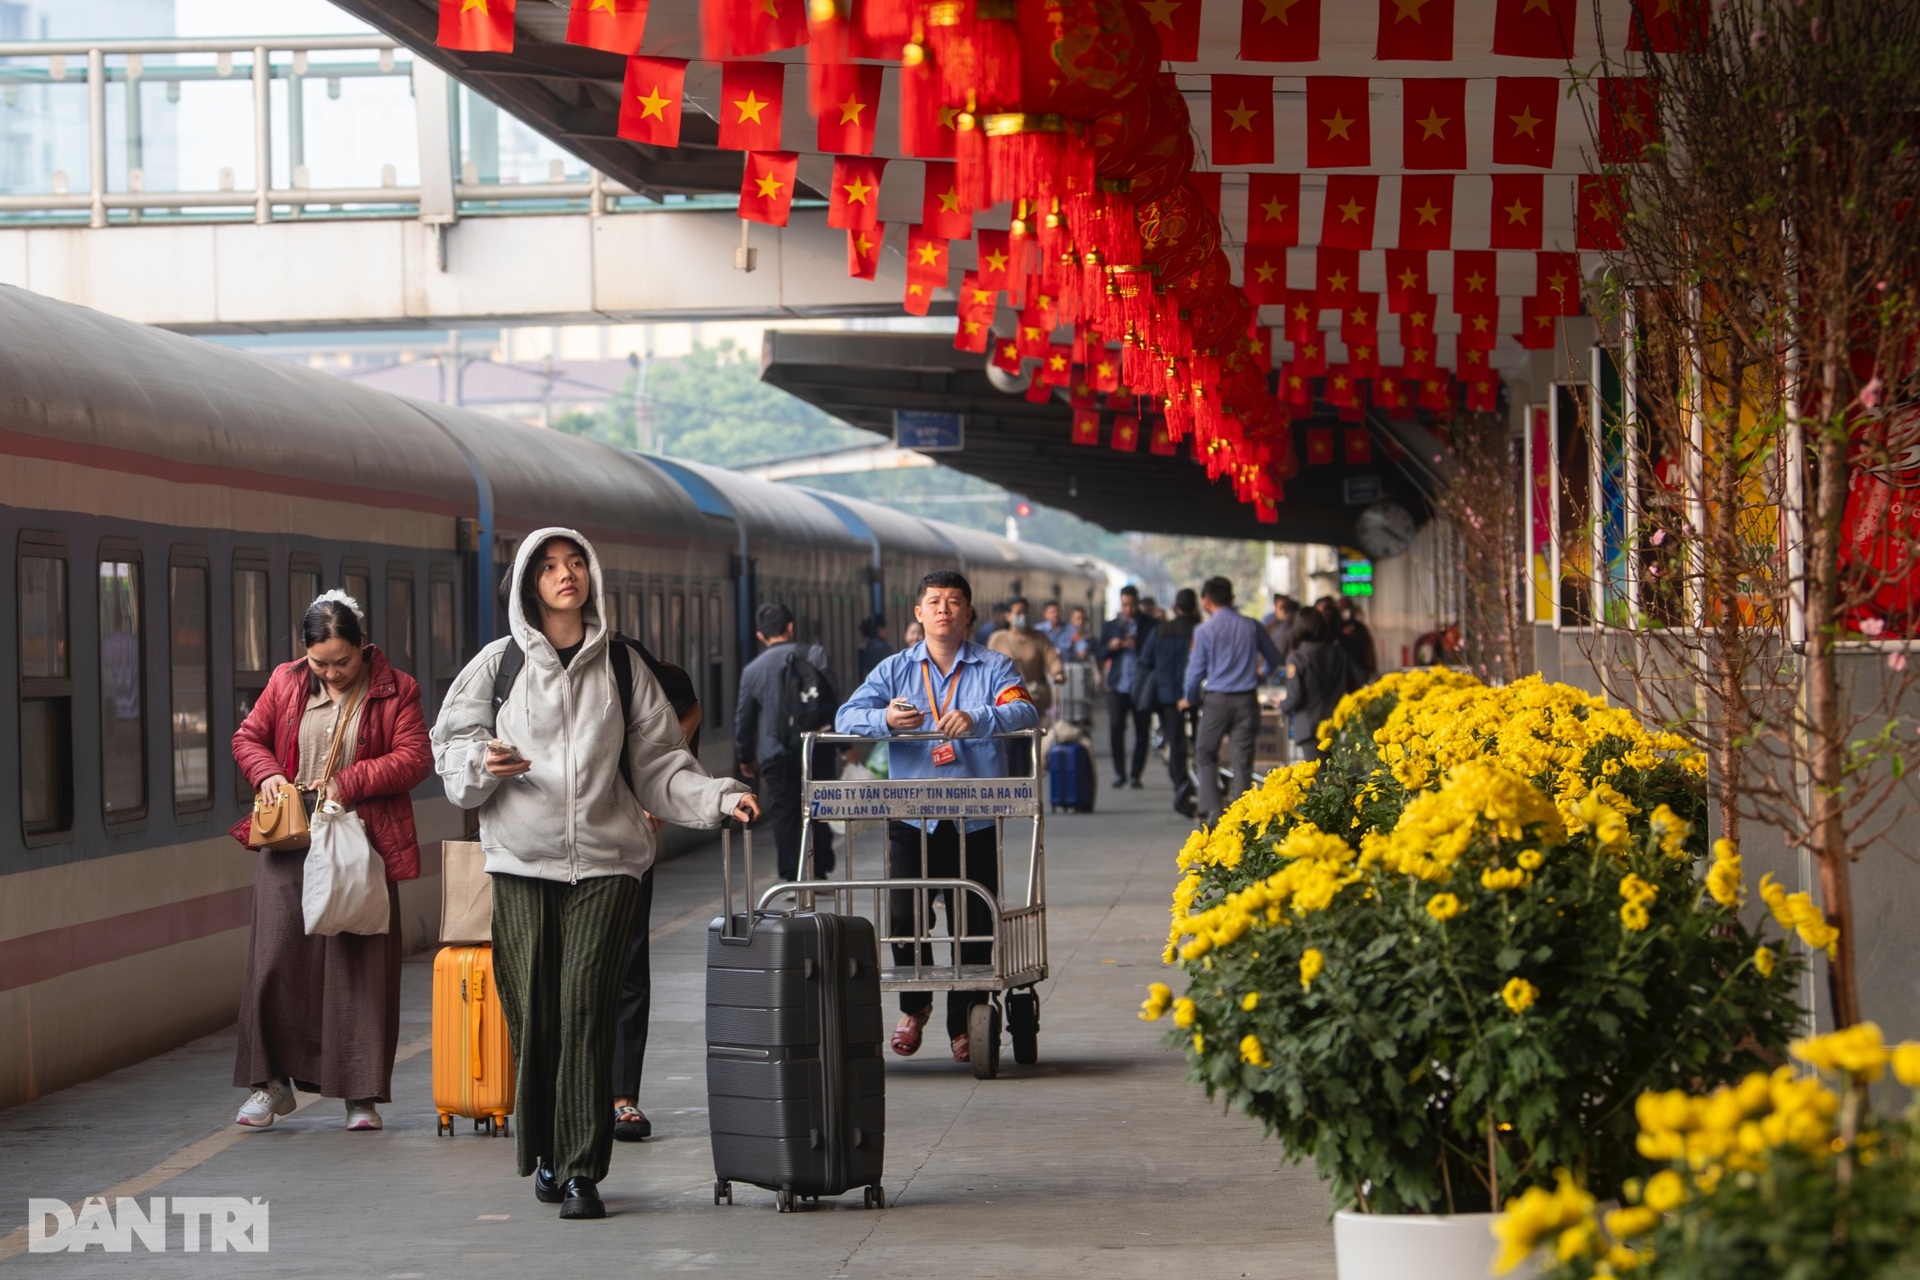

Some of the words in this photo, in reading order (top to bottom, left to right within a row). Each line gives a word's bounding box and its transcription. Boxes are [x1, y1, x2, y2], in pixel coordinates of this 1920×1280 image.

[814, 786, 842, 800] CÔNG
[844, 788, 857, 800] TY
[980, 787, 994, 799] GA
